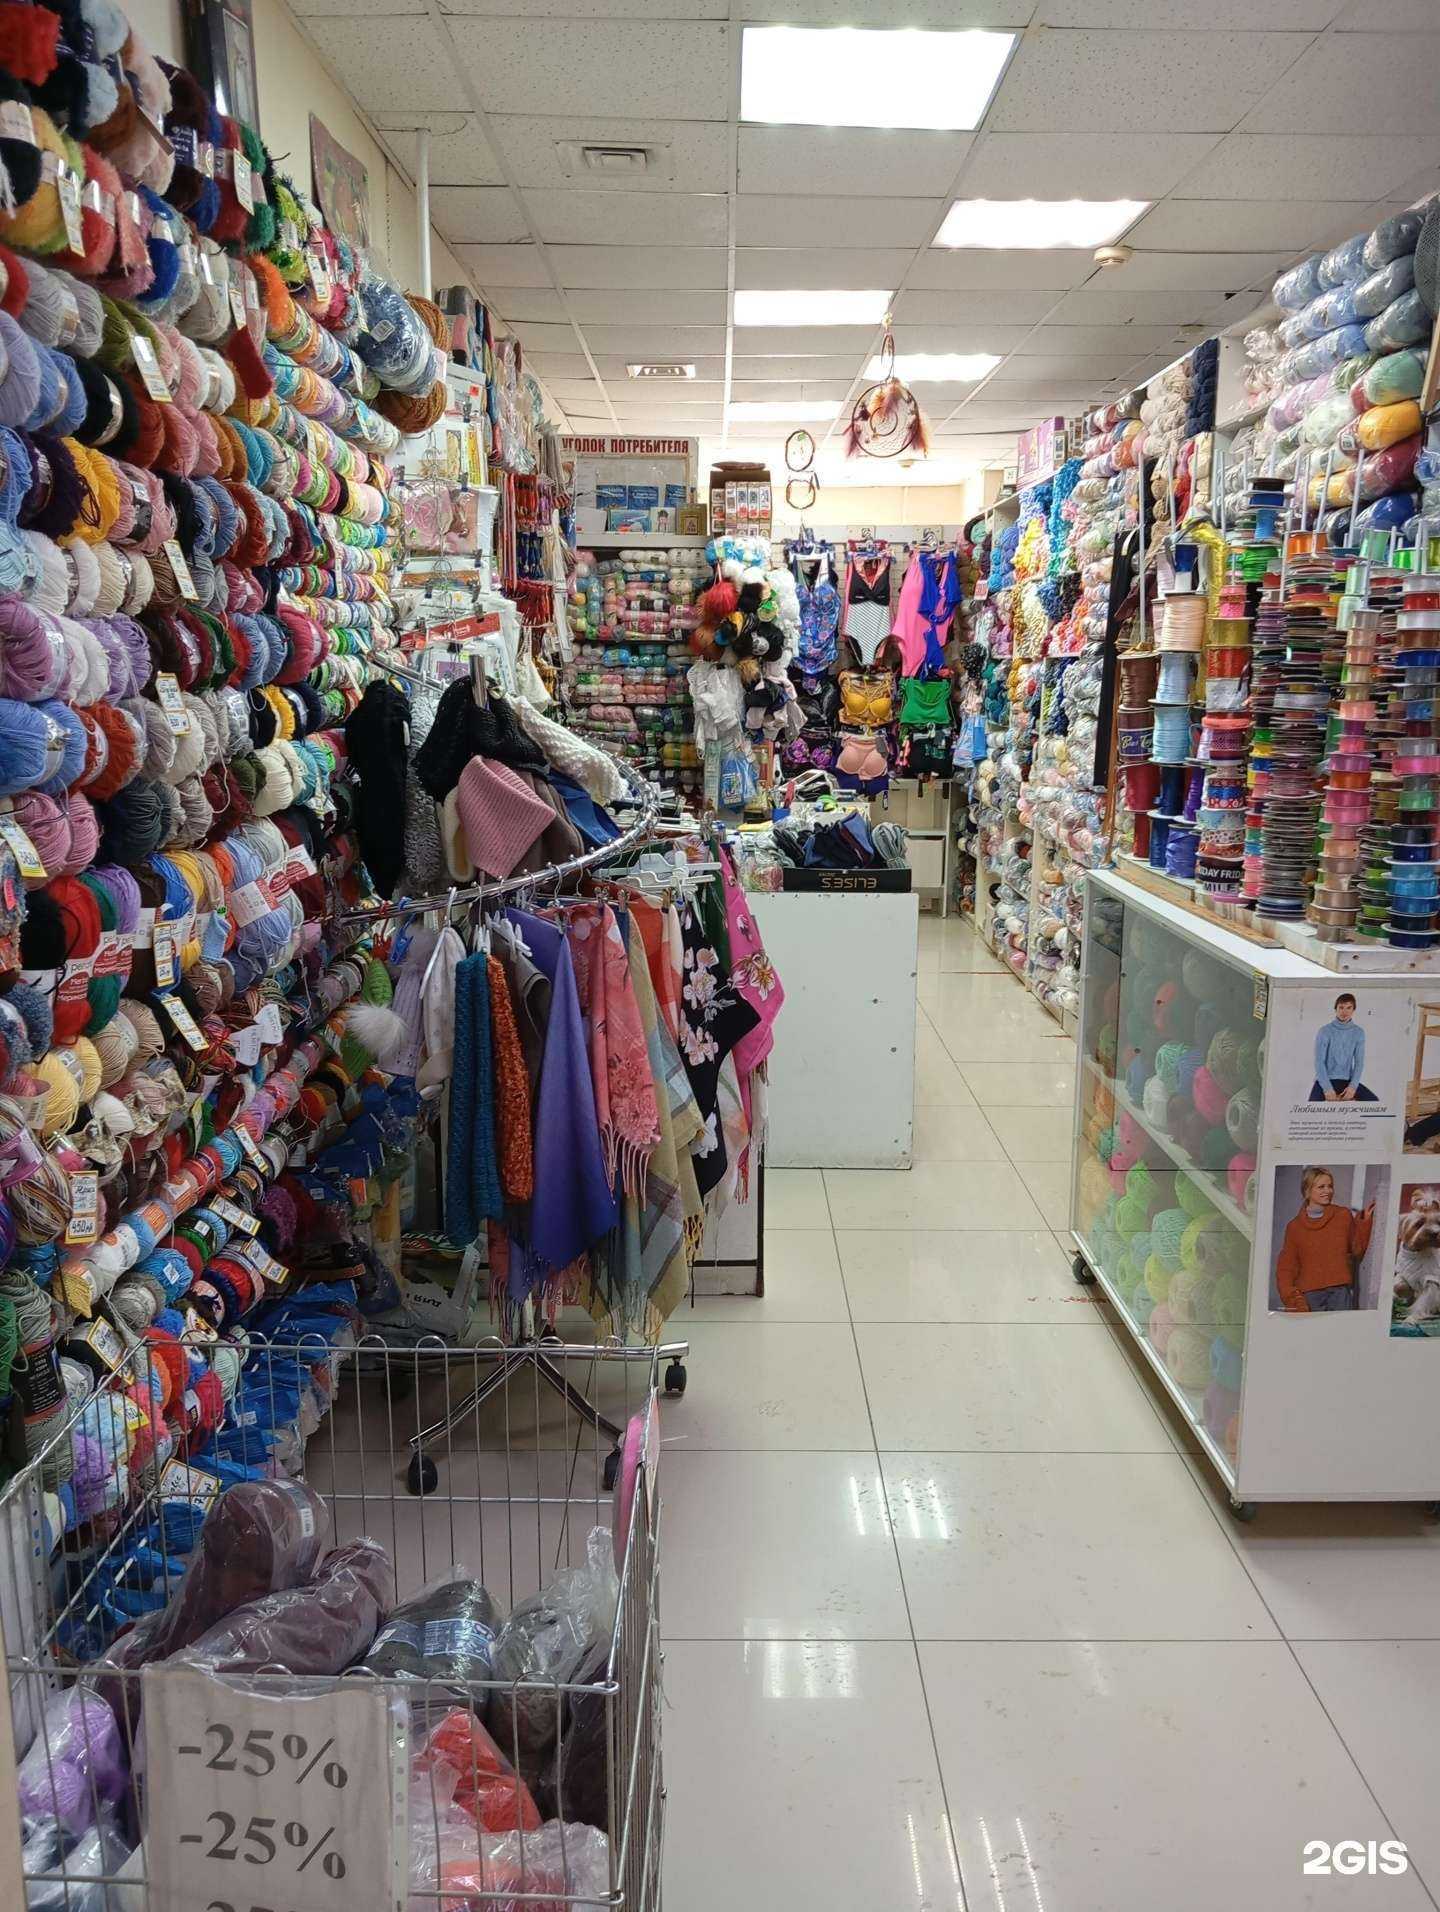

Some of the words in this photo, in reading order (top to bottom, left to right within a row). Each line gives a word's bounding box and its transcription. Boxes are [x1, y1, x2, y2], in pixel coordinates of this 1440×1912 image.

[562, 437, 606, 453] УГОЛОК
[610, 439, 689, 454] ПОТРЕБИТЕЛЯ
[1289, 1104, 1336, 1113] Любимым
[1338, 1104, 1388, 1114] мужчинам
[178, 1723, 348, 1789] -25%
[179, 1810, 346, 1880] -25%
